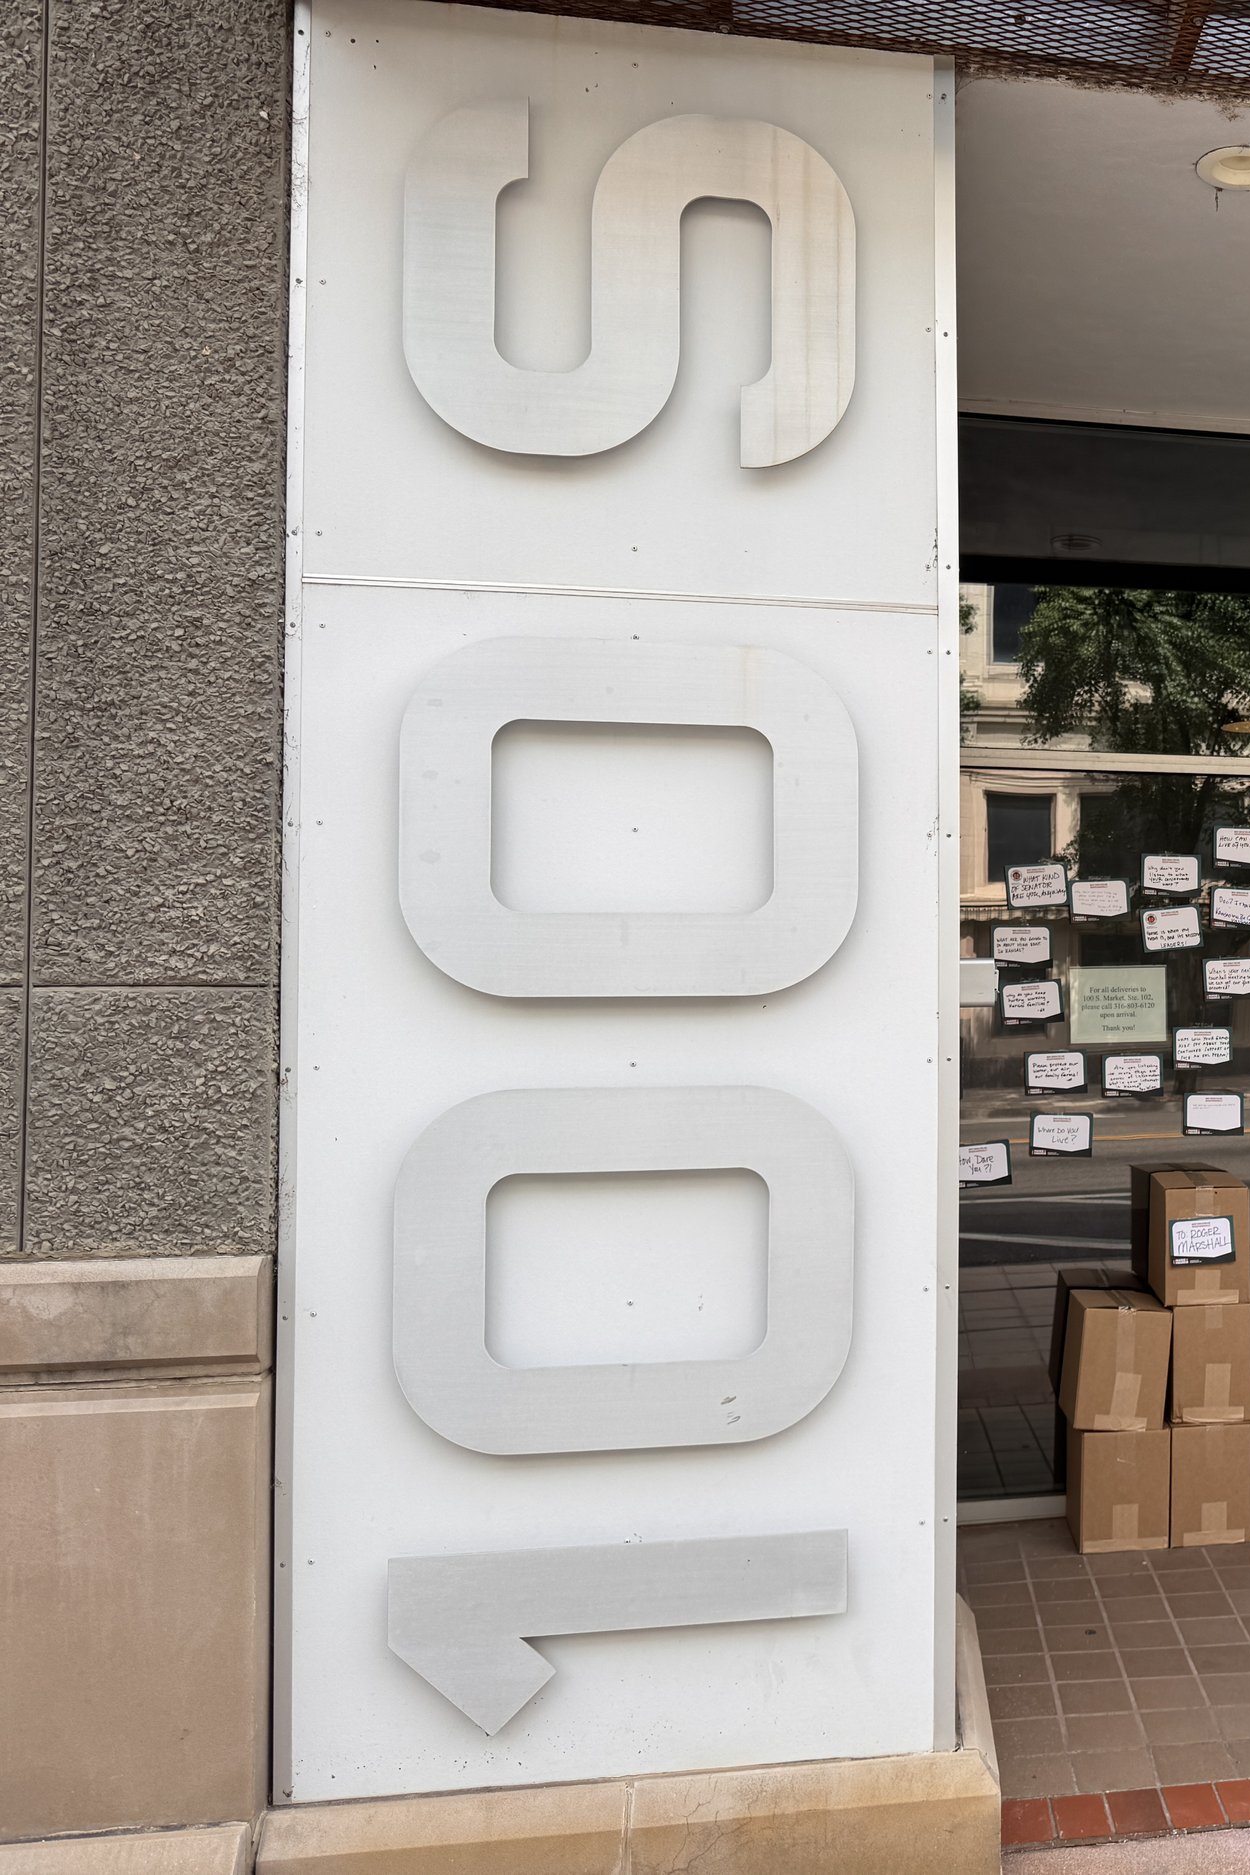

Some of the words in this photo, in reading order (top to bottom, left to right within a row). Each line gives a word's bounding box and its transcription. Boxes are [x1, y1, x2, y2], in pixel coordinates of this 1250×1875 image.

[1023, 876, 1039, 884] WHAT
[1042, 872, 1059, 881] KIND
[1022, 882, 1052, 891] SENATOR
[974, 1155, 994, 1164] Dare
[387, 636, 860, 1736] 100
[1176, 1231, 1186, 1240] TO
[1190, 1227, 1221, 1239] ROGER
[1178, 1236, 1231, 1254] MARSHALL
